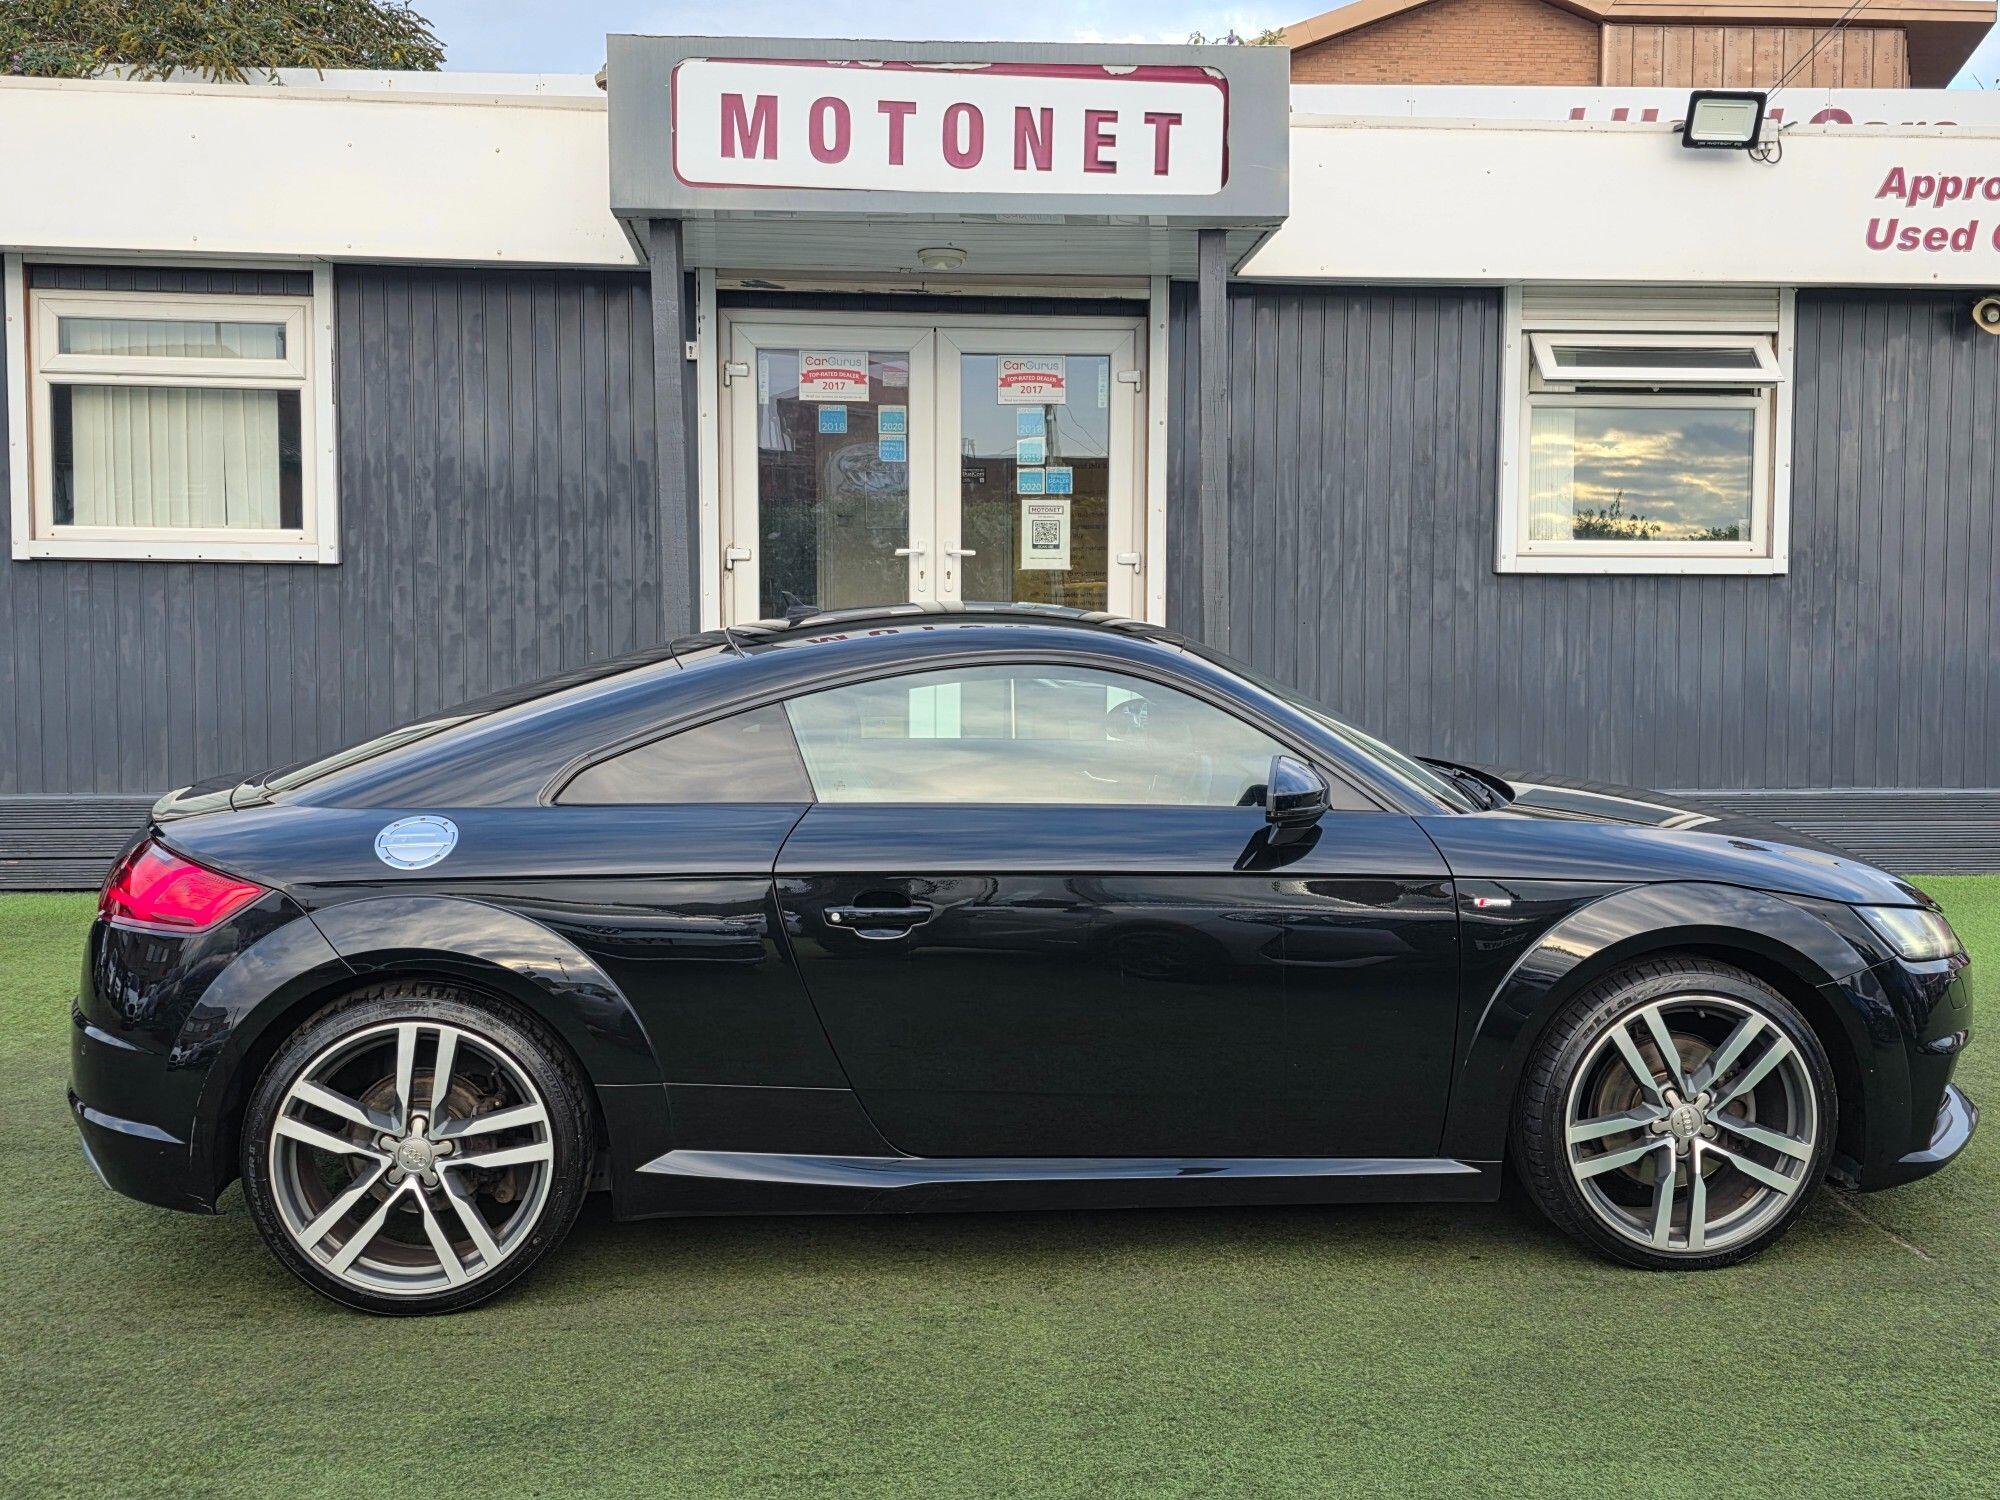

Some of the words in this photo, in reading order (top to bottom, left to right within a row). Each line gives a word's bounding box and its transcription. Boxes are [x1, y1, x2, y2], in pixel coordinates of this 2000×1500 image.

[720, 92, 1183, 177] MOTONET
[1866, 217, 1979, 252] Used
[805, 356, 862, 367] CarGurus
[1003, 360, 1059, 371] CarGurus
[839, 371, 860, 379] DEALER
[822, 381, 846, 391] 2017
[1020, 385, 1043, 394] 2017
[821, 422, 846, 431] 2018
[882, 422, 903, 431] 2020
[1021, 483, 1042, 491] 2020
